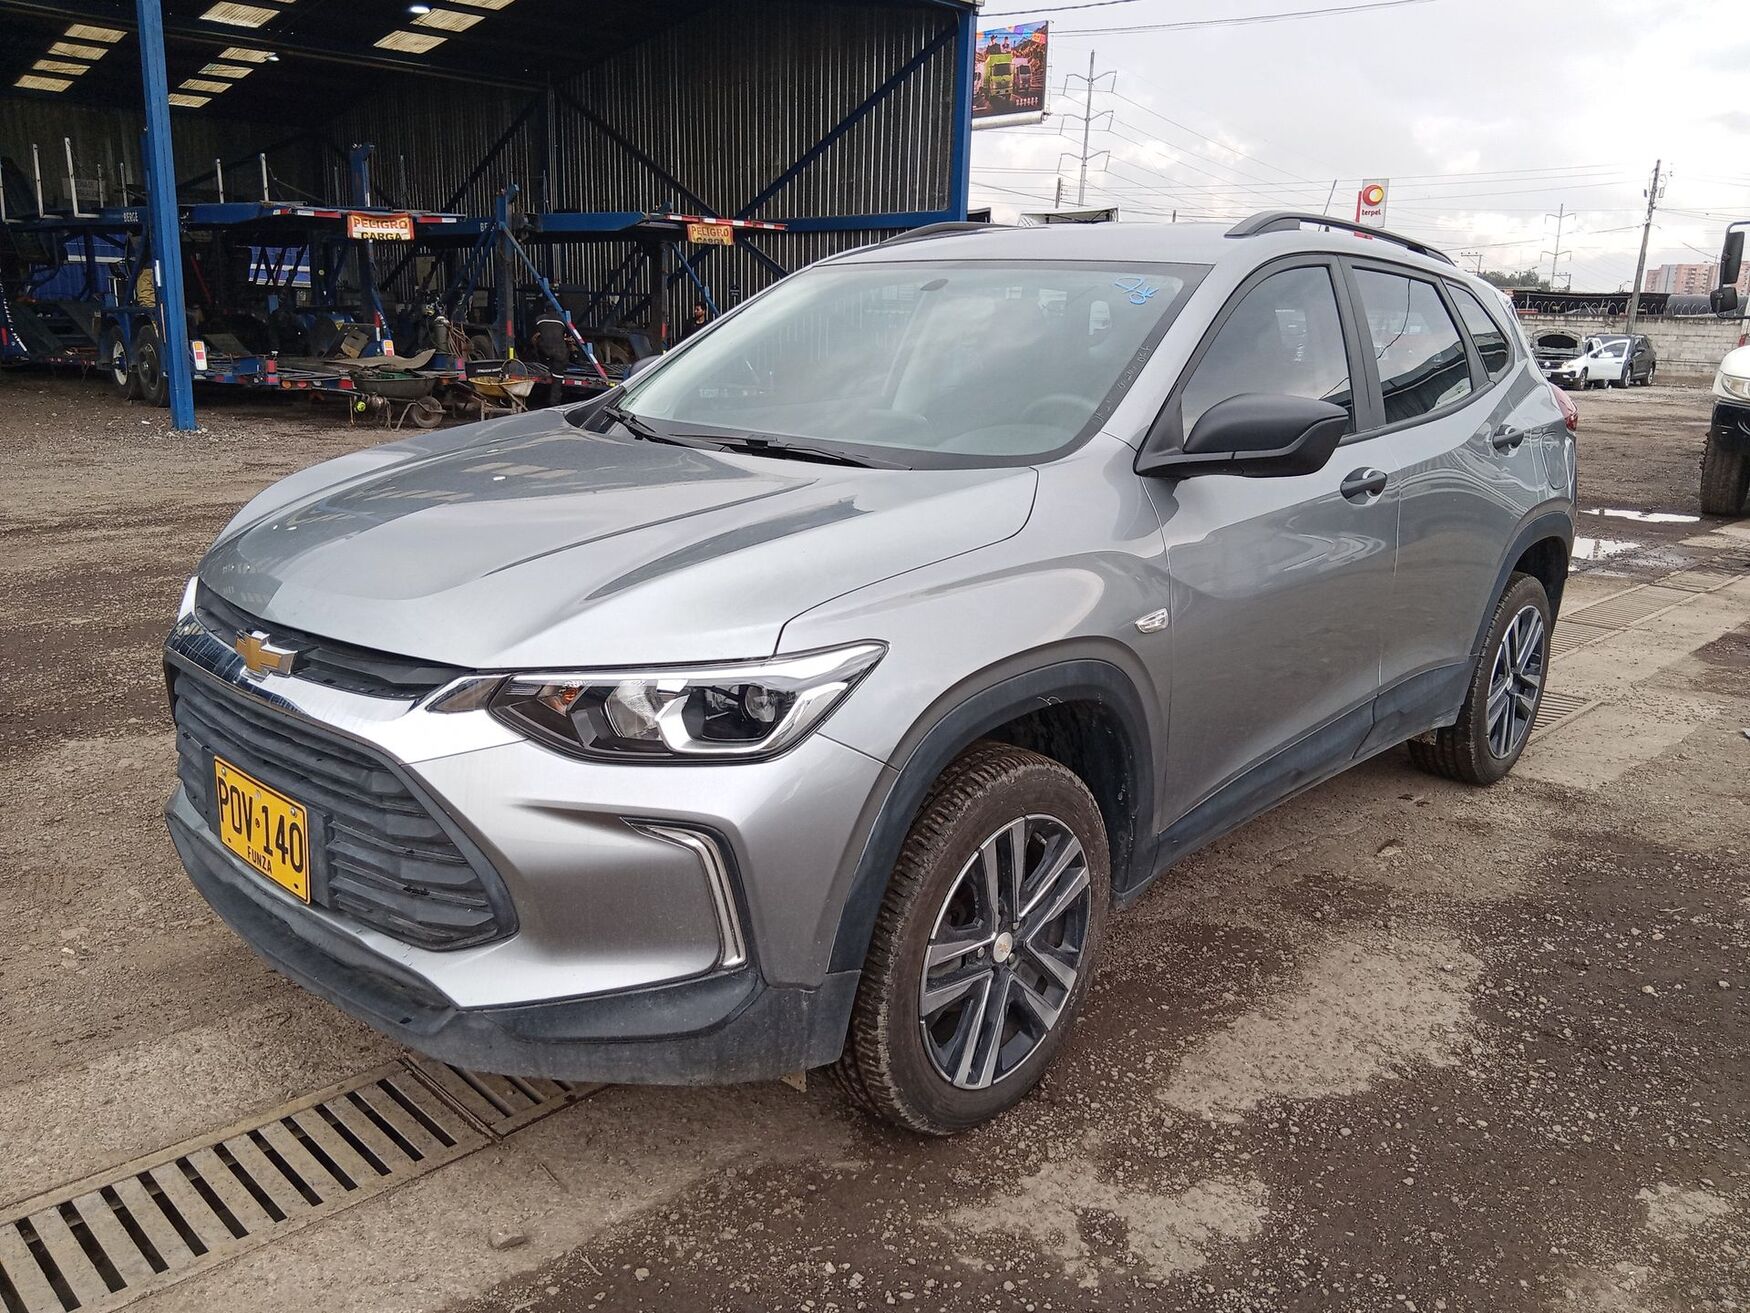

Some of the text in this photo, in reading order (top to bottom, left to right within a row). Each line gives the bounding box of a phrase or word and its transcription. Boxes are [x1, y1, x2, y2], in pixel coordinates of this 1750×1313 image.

[353, 217, 408, 229] PELIGRO
[361, 232, 403, 240] CARGA
[691, 225, 729, 237] PELIGRO
[247, 845, 273, 874] FUNZA
